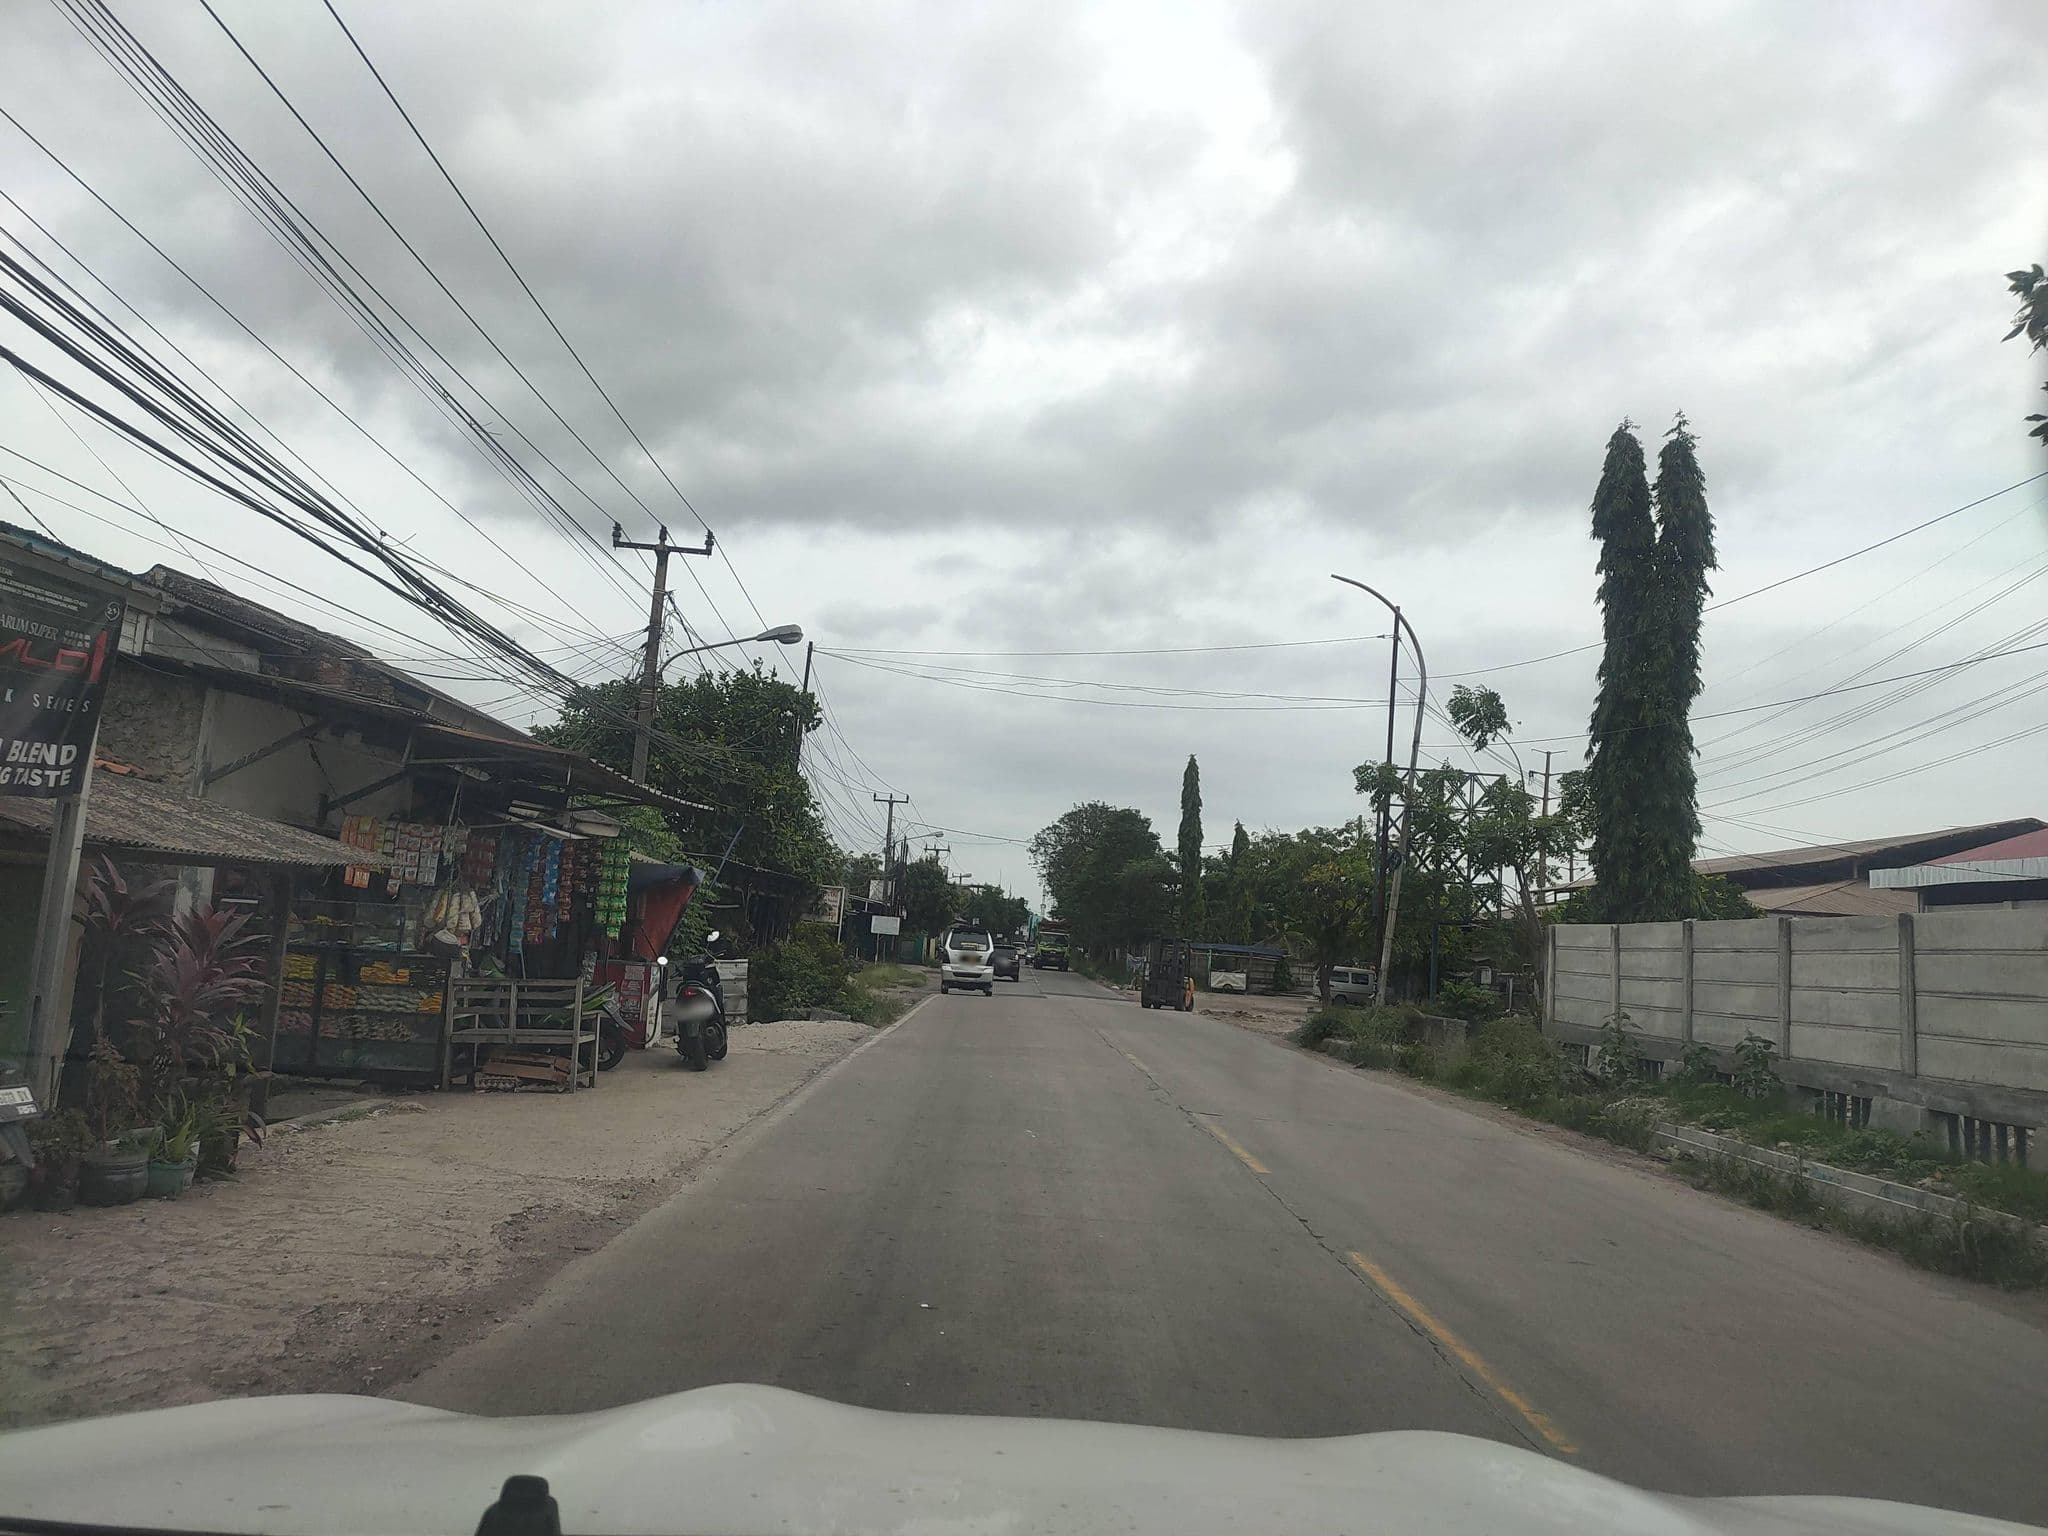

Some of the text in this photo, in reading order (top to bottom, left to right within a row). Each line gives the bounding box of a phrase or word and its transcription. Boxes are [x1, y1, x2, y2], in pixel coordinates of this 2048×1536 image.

[28, 622, 59, 641] SUPER
[6, 740, 78, 766] BLEND
[13, 767, 73, 788] TASTE
